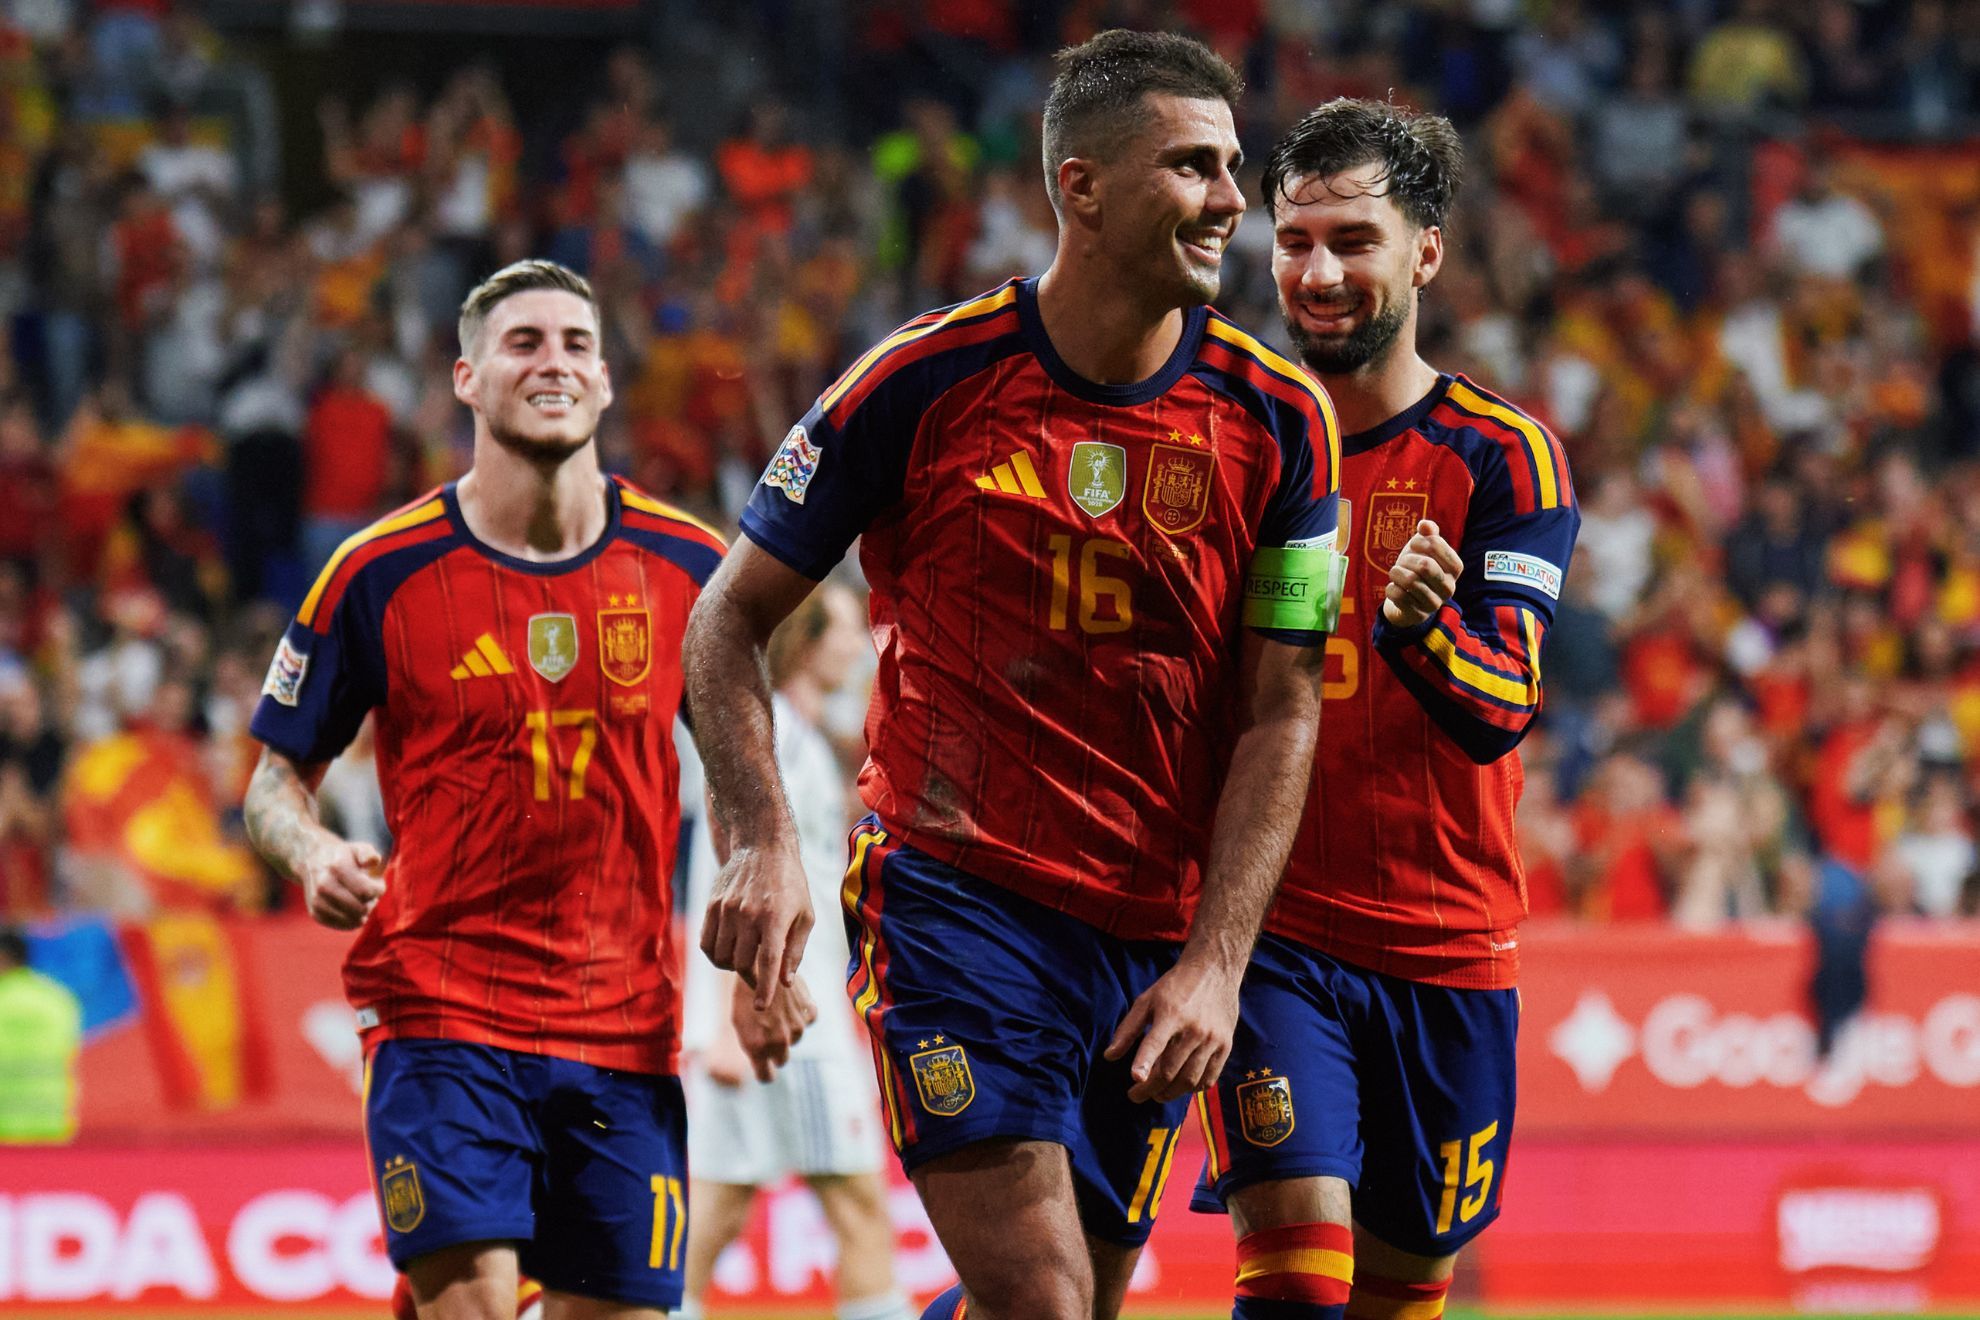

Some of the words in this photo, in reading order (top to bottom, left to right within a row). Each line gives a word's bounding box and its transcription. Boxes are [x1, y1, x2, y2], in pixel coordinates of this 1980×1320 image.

[1084, 487, 1109, 499] FIFA
[1048, 534, 1133, 635] 16
[1247, 580, 1309, 597] RESPECT
[1487, 560, 1559, 588] FOUNDATION
[526, 709, 596, 801] 17
[1436, 1119, 1499, 1235] 15
[0, 1190, 217, 1301] DA
